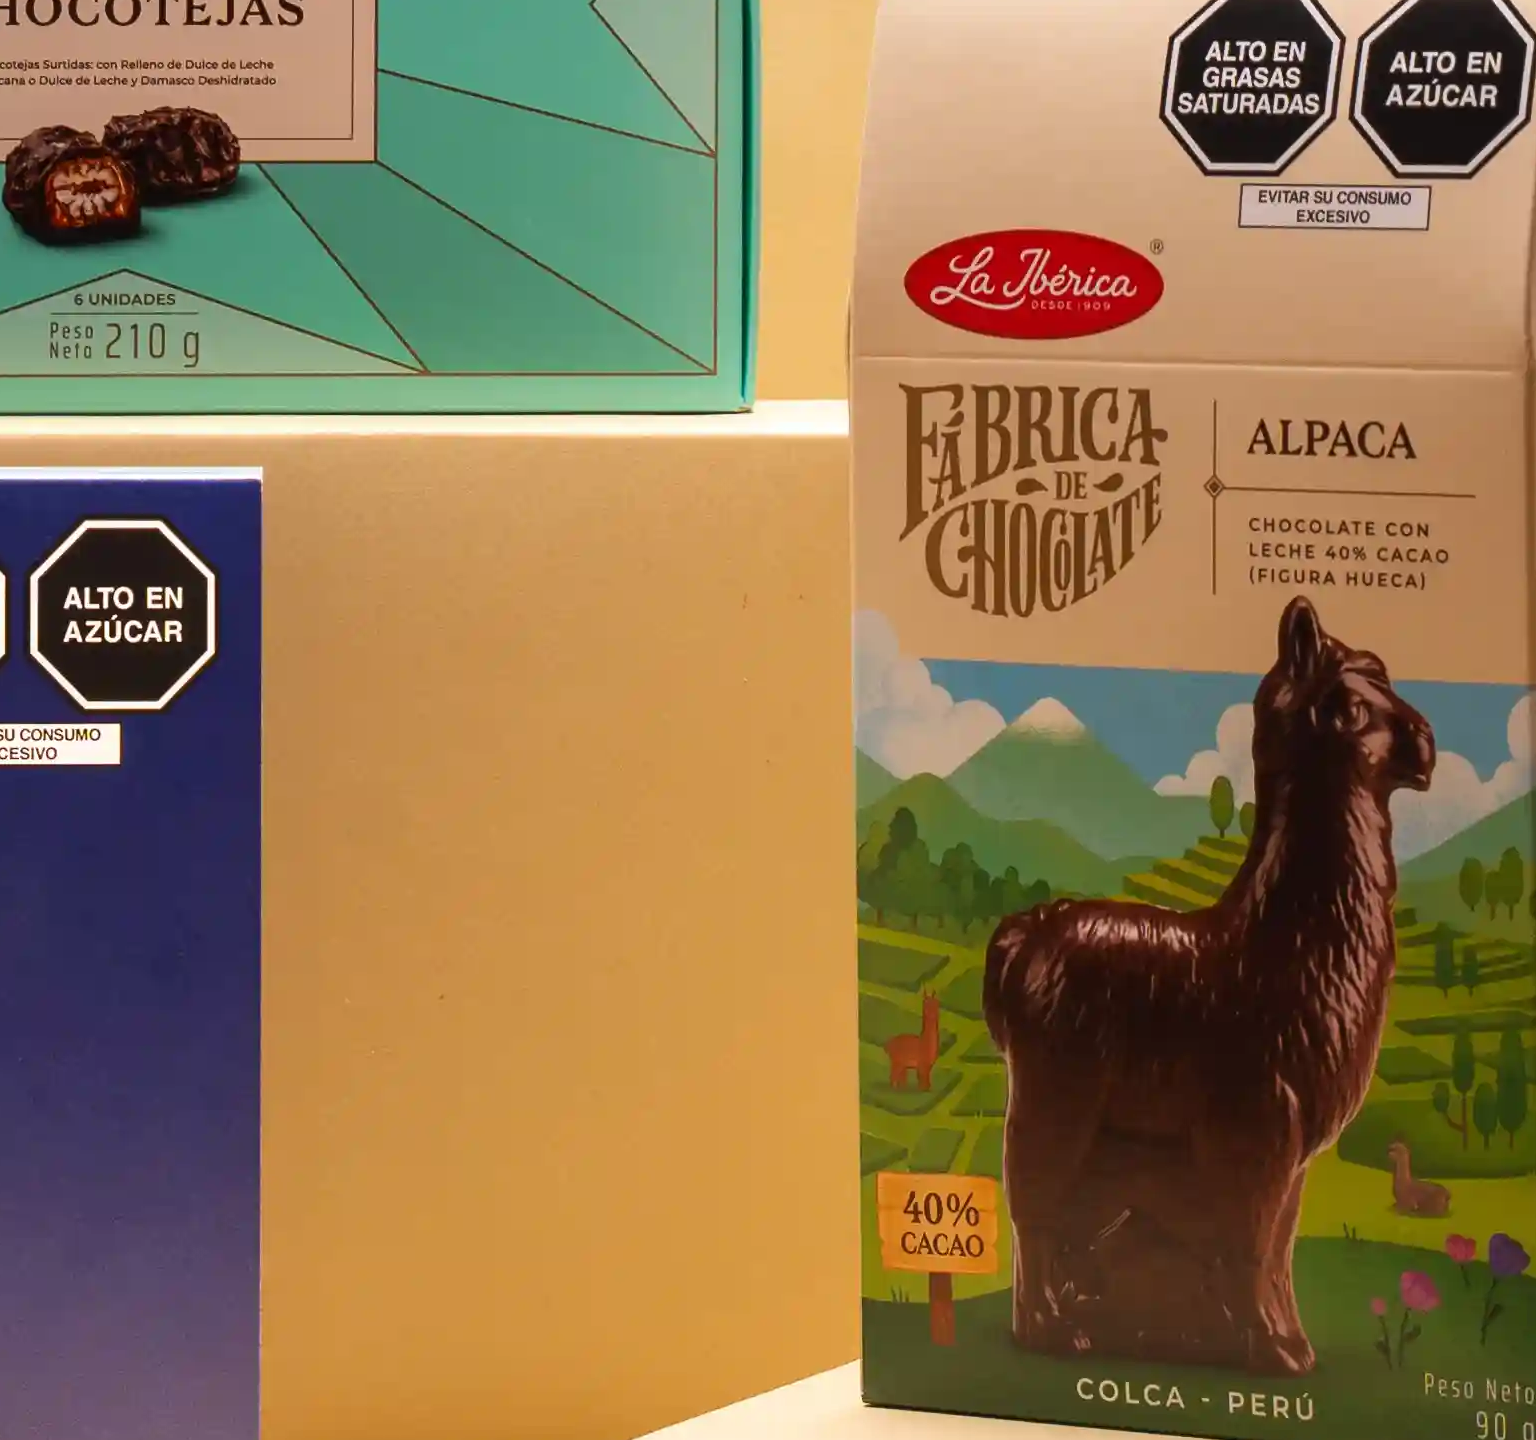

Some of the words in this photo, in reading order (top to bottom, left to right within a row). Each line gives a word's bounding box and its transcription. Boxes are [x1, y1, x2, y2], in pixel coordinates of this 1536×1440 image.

[1205, 41, 1266, 62] ALTO
[1273, 41, 1306, 62] EN
[1390, 51, 1455, 74] ALTO
[1466, 51, 1502, 73] EN
[96, 62, 117, 70] con
[121, 60, 163, 70] Relleno
[167, 60, 182, 70] de
[185, 60, 218, 70] Dulce
[221, 60, 236, 70] de
[240, 60, 274, 70] Leche
[28, 78, 36, 86] o
[39, 75, 72, 86] Dulce
[76, 75, 90, 86] de
[94, 75, 128, 86] Leche
[131, 77, 138, 88] y
[141, 75, 194, 86] Damasco
[198, 75, 276, 86] Deshidratado
[1203, 67, 1301, 88] GRASAS
[1177, 92, 1320, 115] SATURADAS
[1386, 79, 1498, 108] AZÚCAR
[1258, 190, 1310, 204] EVITAR
[1314, 191, 1333, 204] SU
[1337, 191, 1411, 205] CONSUMO
[1296, 209, 1370, 224] EXCESIVO
[930, 247, 1025, 310] La
[1002, 248, 1137, 297] Ibérica
[74, 294, 83, 306] 6
[89, 293, 176, 306] UNIDADES
[1031, 300, 1072, 310] DESDE
[1077, 301, 1111, 311] 1909
[50, 322, 94, 339] Peso
[50, 342, 93, 359] Neto
[106, 323, 166, 358] 210
[183, 331, 200, 368] g
[1247, 418, 1417, 459] ALPACA
[899, 382, 1168, 542] FÁBRICA
[1054, 471, 1088, 500] DE
[1249, 518, 1375, 536] CHOCOLATE
[1385, 522, 1430, 538] CON
[925, 472, 1162, 618] CHOCOLATE
[1249, 543, 1315, 559] LECHE
[1325, 546, 1367, 561] 40%
[1377, 548, 1449, 564] CACAO
[1249, 566, 1336, 585] (FIGURA
[1346, 572, 1426, 590] HUECA)
[64, 587, 134, 610] ALTO
[147, 587, 183, 609] EN
[64, 615, 182, 643] AZÚCAR
[20, 729, 101, 742] CONSUMO
[903, 1191, 979, 1227] 40%
[901, 1232, 984, 1257] CACAO
[1076, 1378, 1185, 1409] COLCA
[1228, 1391, 1314, 1421] PERÚ
[1424, 1372, 1474, 1400] Peso
[1486, 1378, 1535, 1405] Neto
[1476, 1411, 1507, 1440] 90
